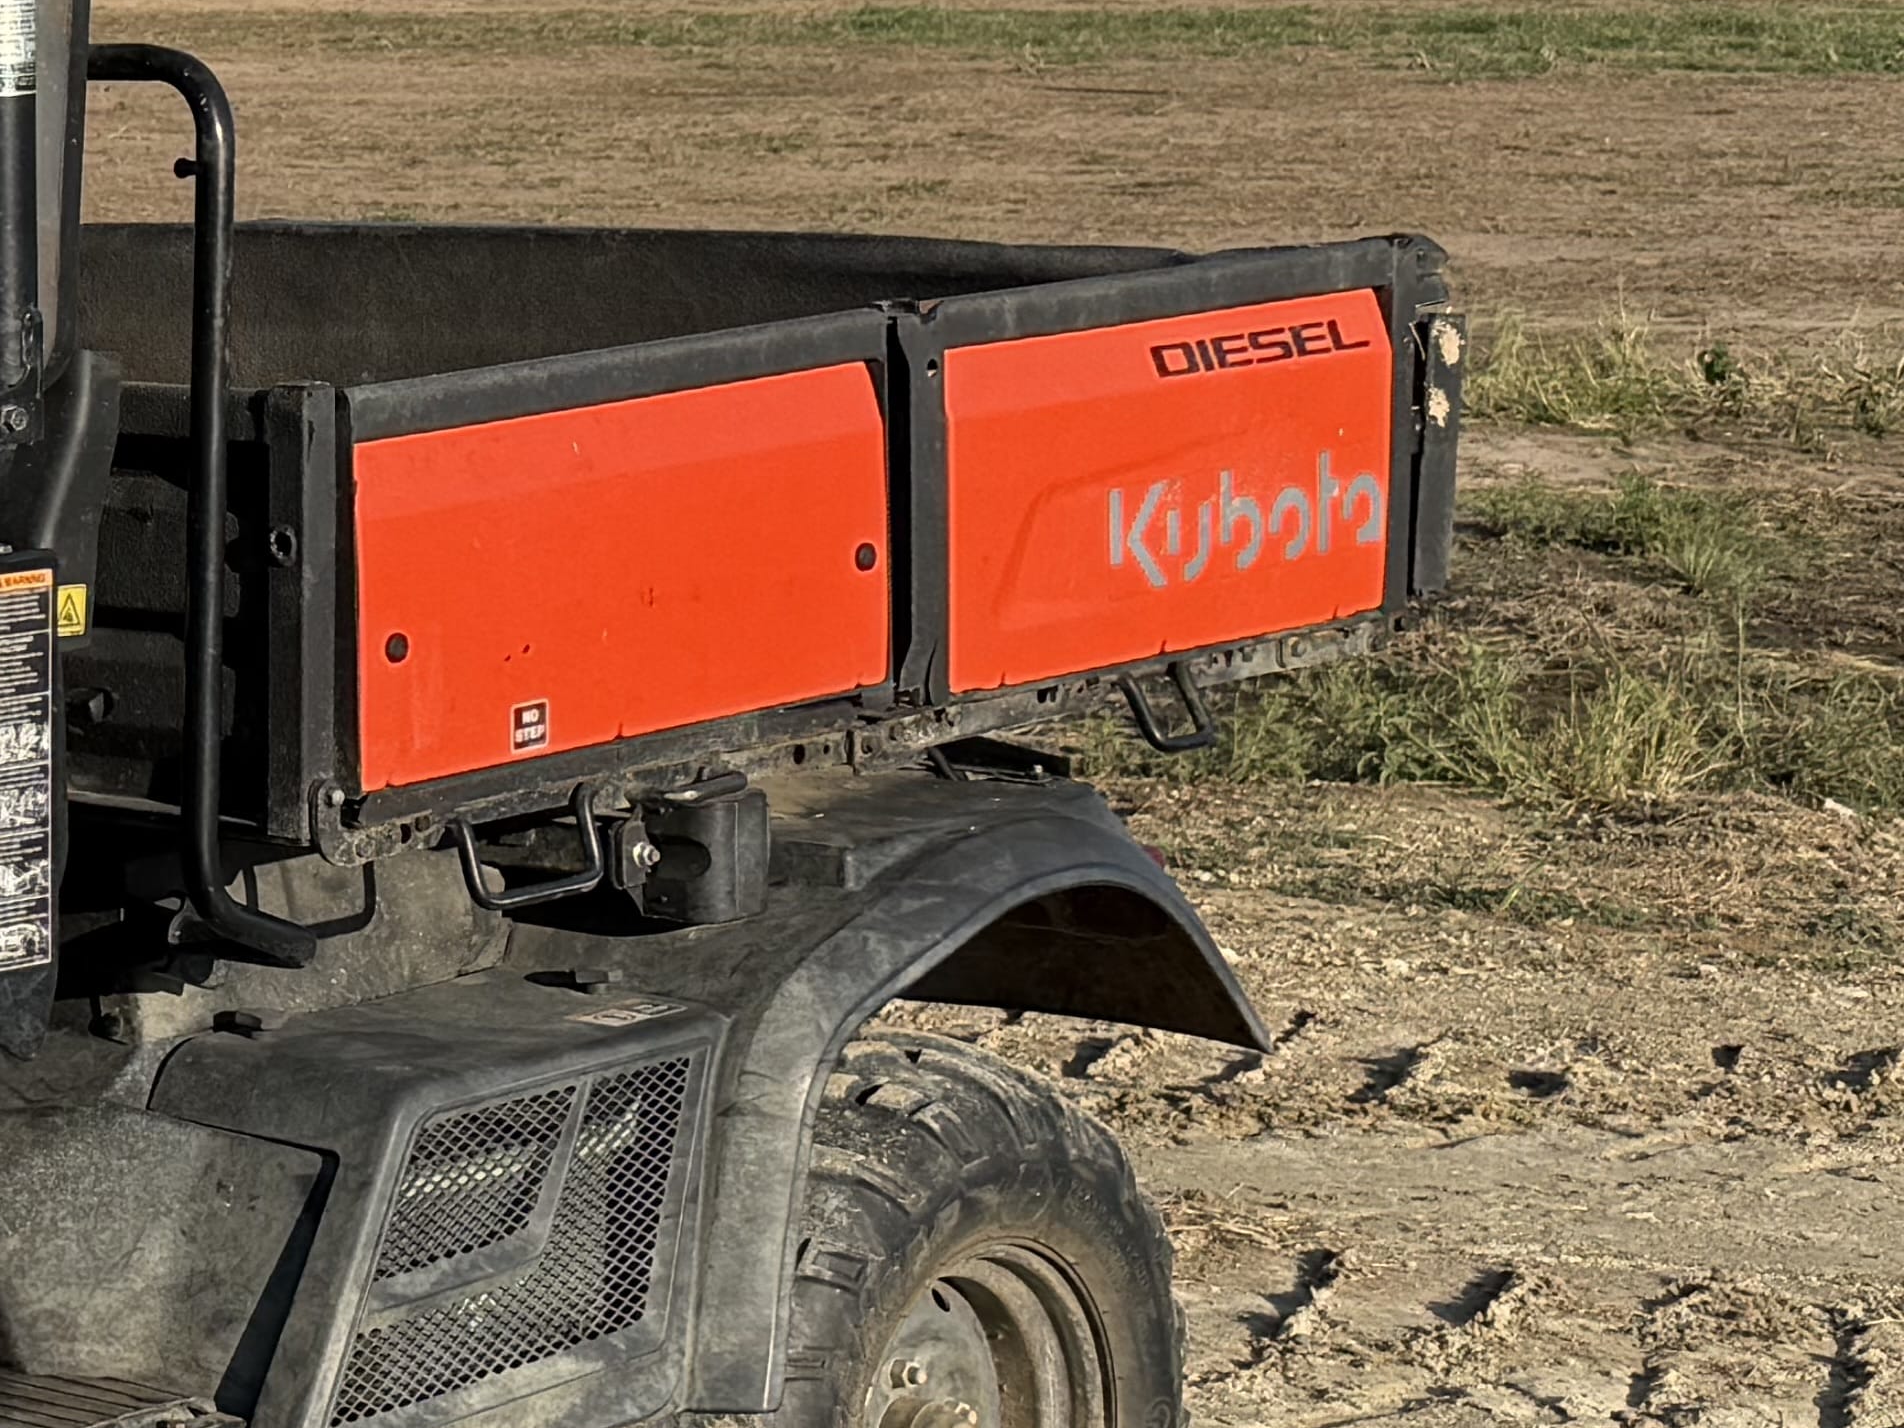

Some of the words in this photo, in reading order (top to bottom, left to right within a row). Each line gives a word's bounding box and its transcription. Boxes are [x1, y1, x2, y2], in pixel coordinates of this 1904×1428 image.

[1150, 318, 1371, 378] DIESEL
[1108, 450, 1382, 589] Kubota
[515, 724, 545, 743] STEP
[521, 708, 540, 725] NO
